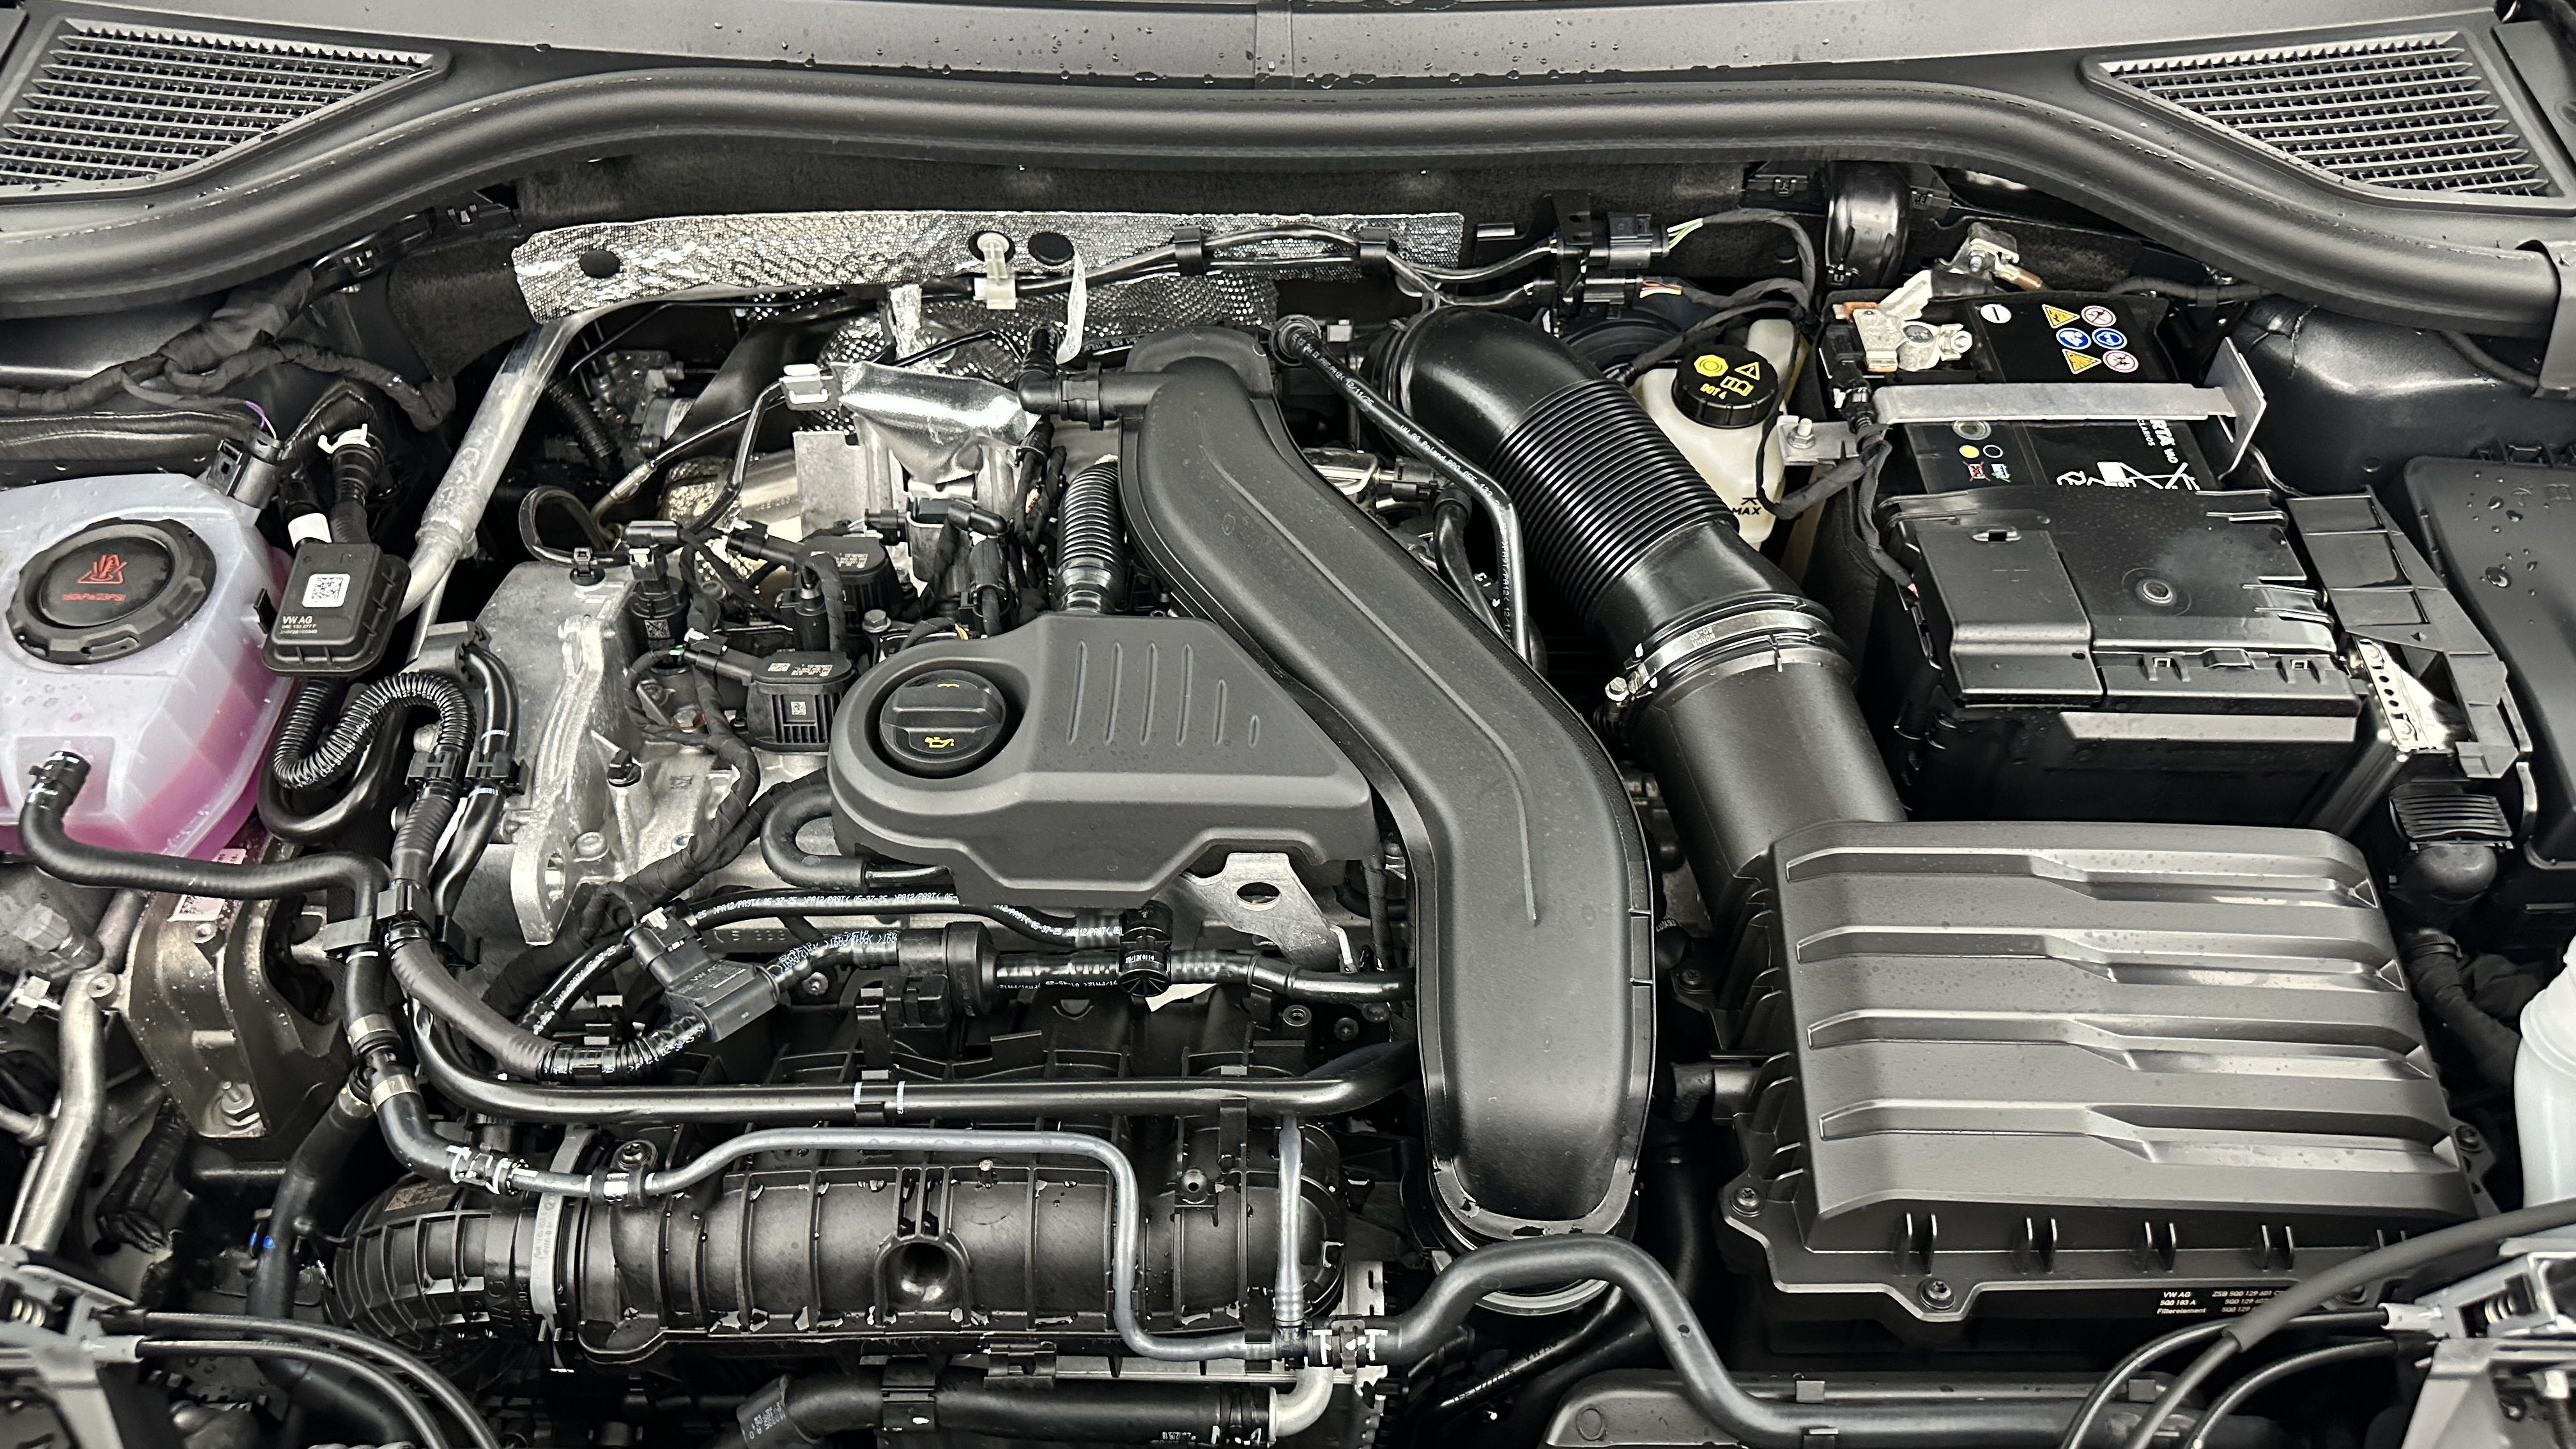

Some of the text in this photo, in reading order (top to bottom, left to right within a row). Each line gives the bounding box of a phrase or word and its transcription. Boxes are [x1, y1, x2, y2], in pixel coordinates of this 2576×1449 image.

[1700, 383, 1727, 399] DOT 4
[2136, 418, 2156, 446] CLARIOS
[2149, 419, 2176, 447] RTA
[1420, 440, 1446, 462] Poland
[1731, 507, 1761, 515] MAX
[282, 615, 313, 624] VW AG
[763, 896, 798, 906] 05-37-25
[852, 894, 888, 904] 05-37-25
